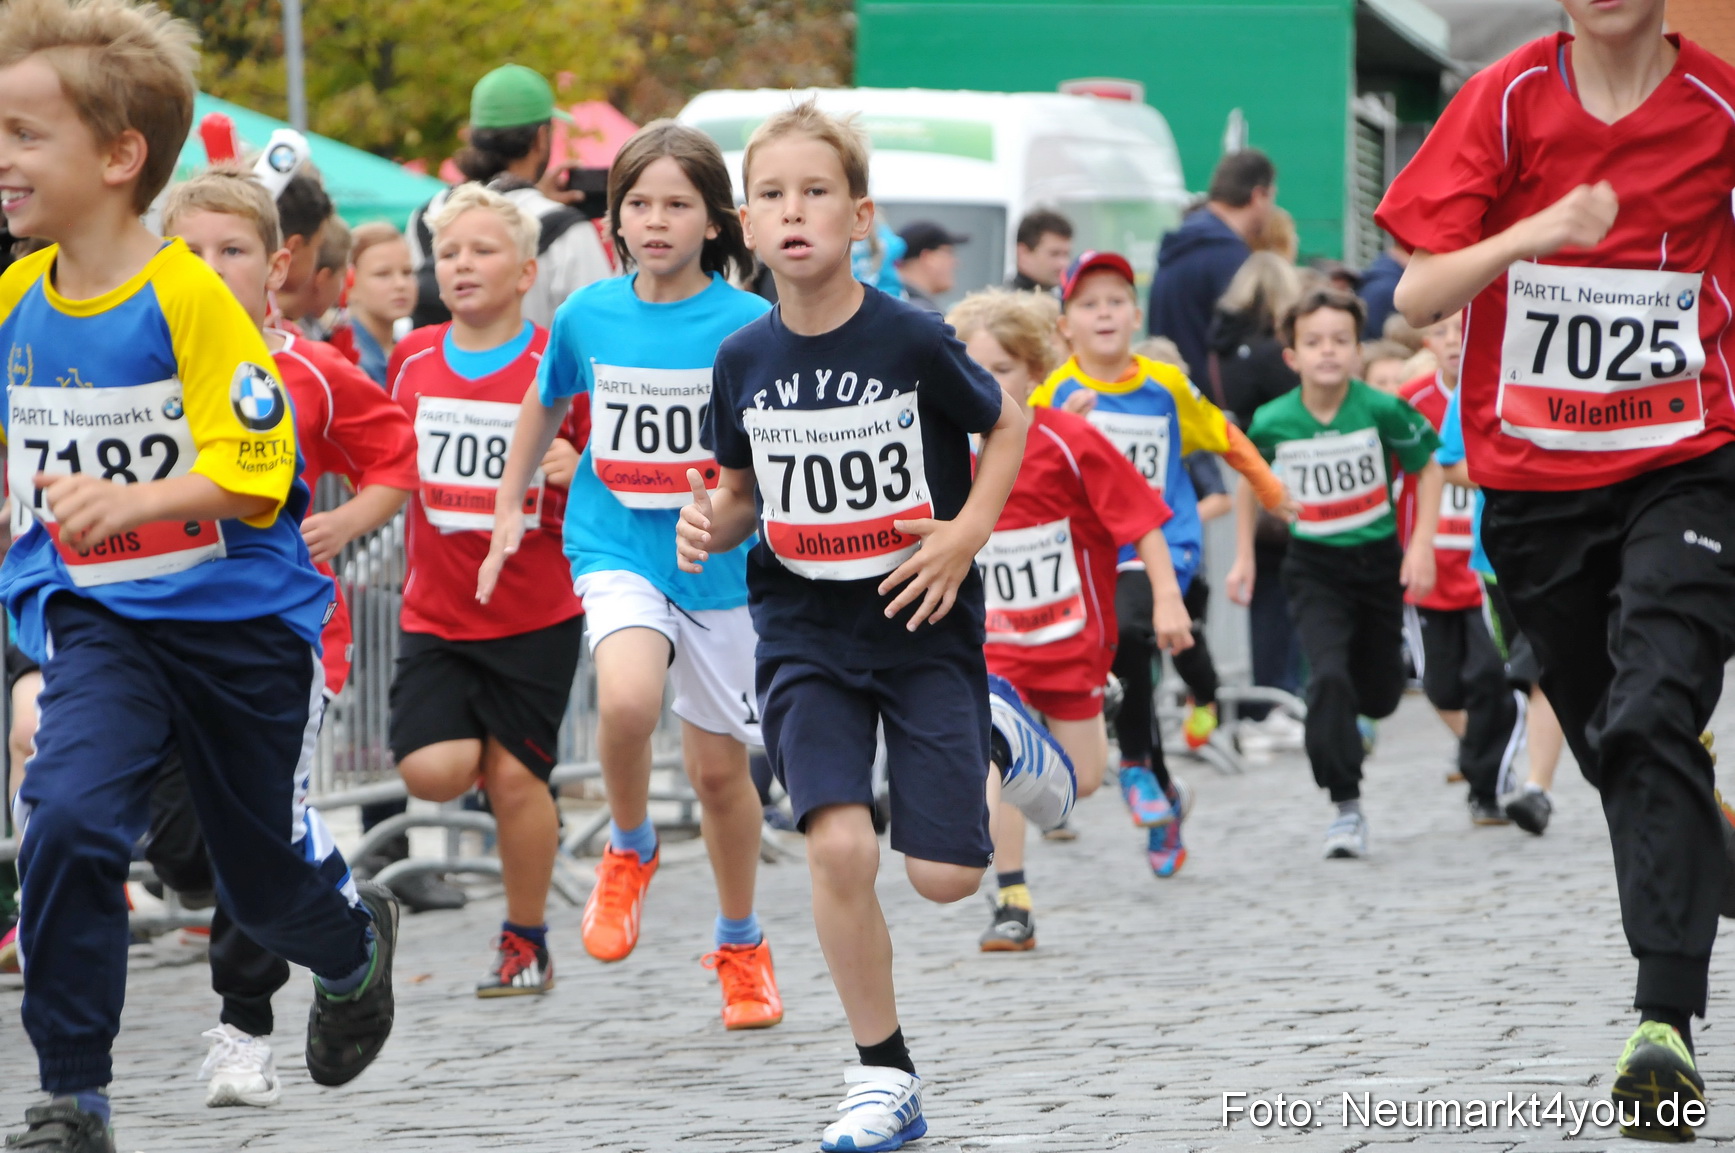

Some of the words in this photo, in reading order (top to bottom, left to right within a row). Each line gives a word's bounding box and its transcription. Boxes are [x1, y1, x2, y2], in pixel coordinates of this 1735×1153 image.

[1514, 280, 1571, 302] PARTL
[1578, 287, 1670, 307] Neumarkt
[1526, 310, 1687, 381] 7025
[597, 379, 637, 395] PARTL
[641, 383, 711, 397] Neumarkt
[12, 407, 58, 426] PARTL
[63, 407, 153, 426] Neumarkt
[463, 413, 514, 428] Neumar
[1548, 396, 1652, 425] Valentin
[753, 427, 803, 444] PARTL
[806, 419, 892, 444] Neumarkt
[428, 430, 507, 479] 708
[24, 433, 179, 508] 7182
[768, 441, 911, 514] 7093
[1291, 455, 1375, 495] 7088
[431, 487, 496, 510] Maximi
[796, 529, 903, 556] Johannes
